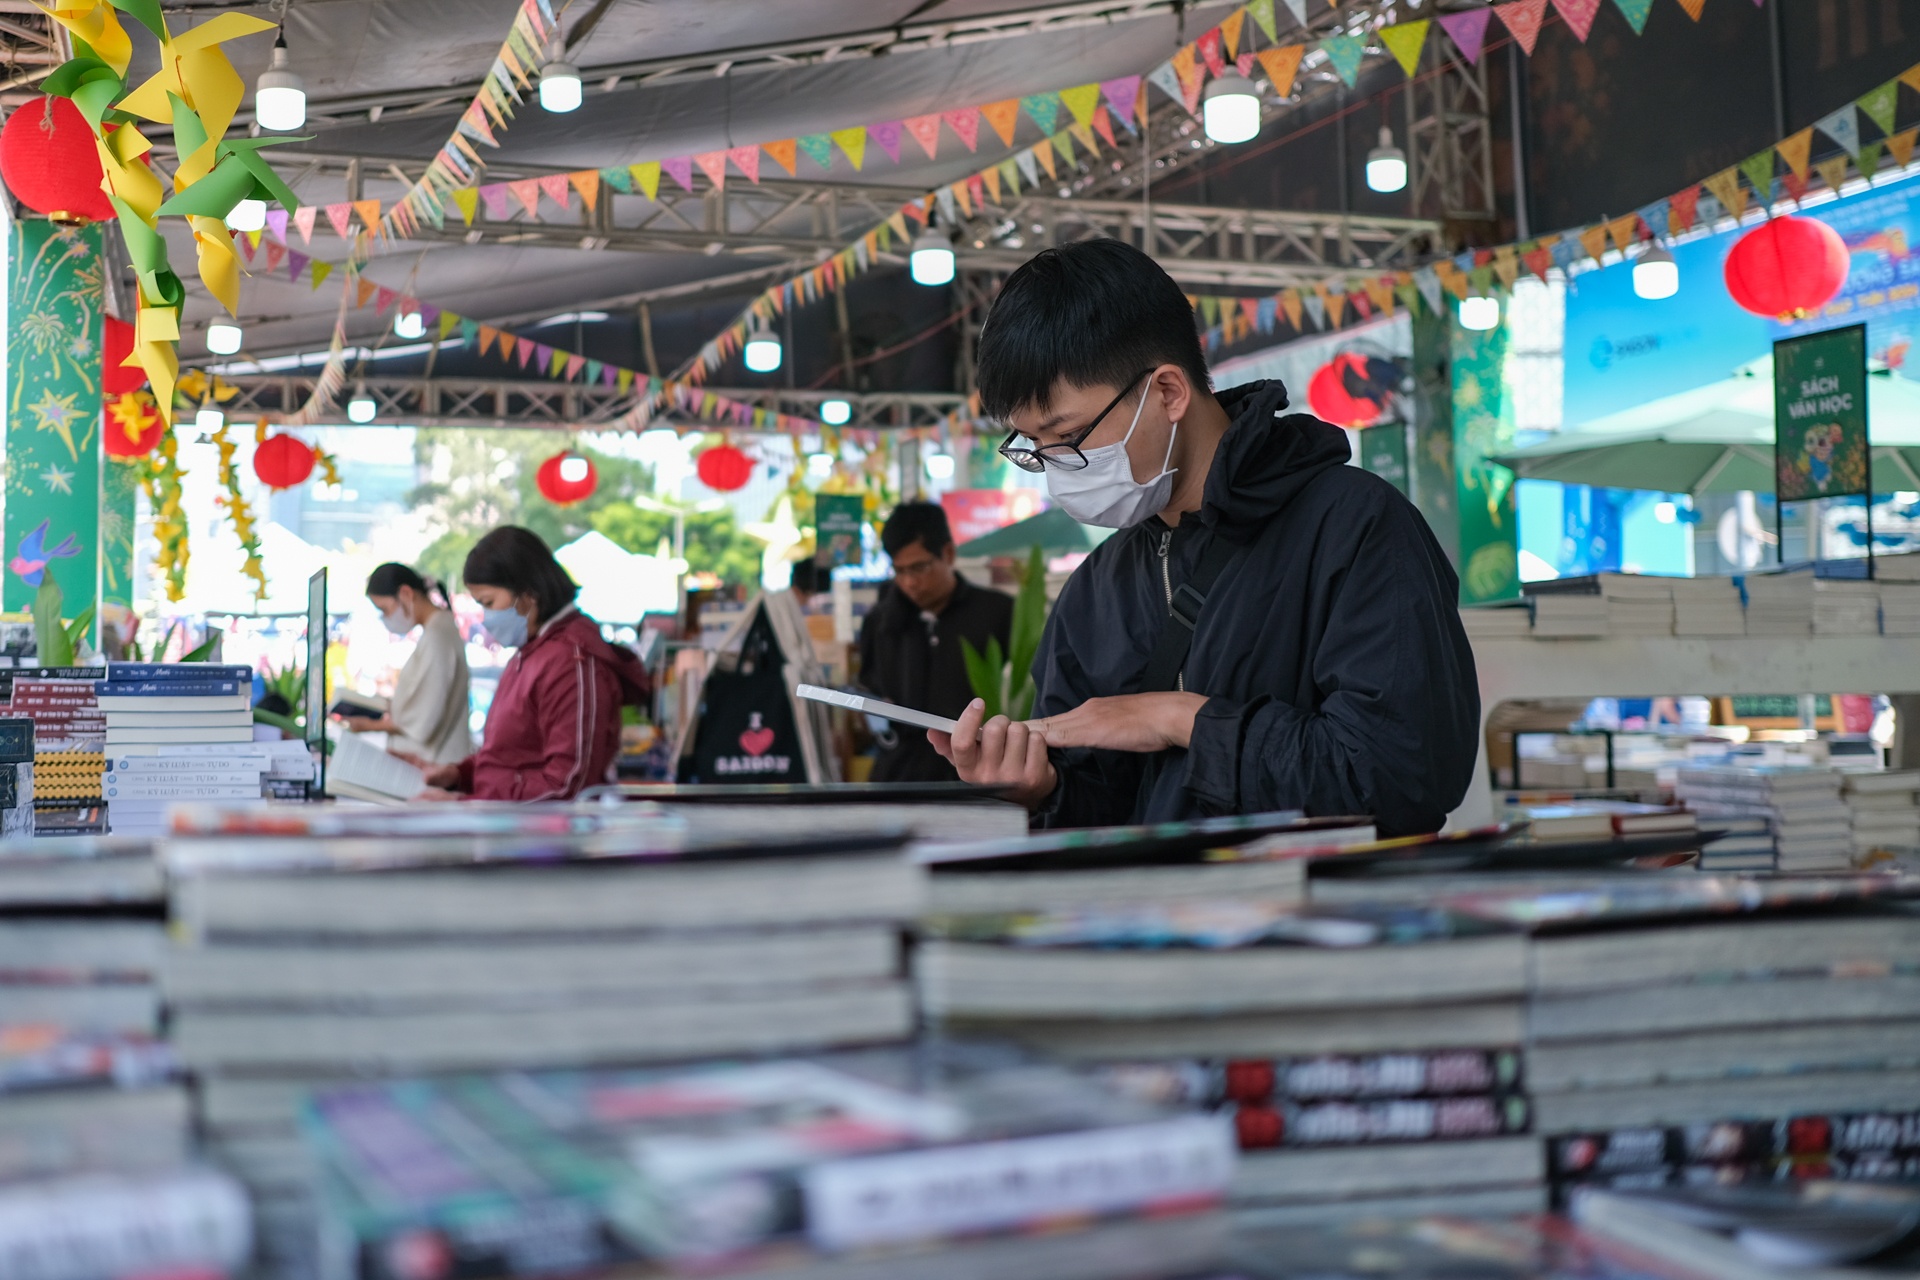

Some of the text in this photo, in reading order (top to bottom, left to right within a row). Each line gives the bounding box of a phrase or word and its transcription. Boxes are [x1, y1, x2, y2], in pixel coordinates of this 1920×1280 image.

[1801, 376, 1839, 398] SÁCH
[1789, 393, 1853, 419] VĂN HỌC
